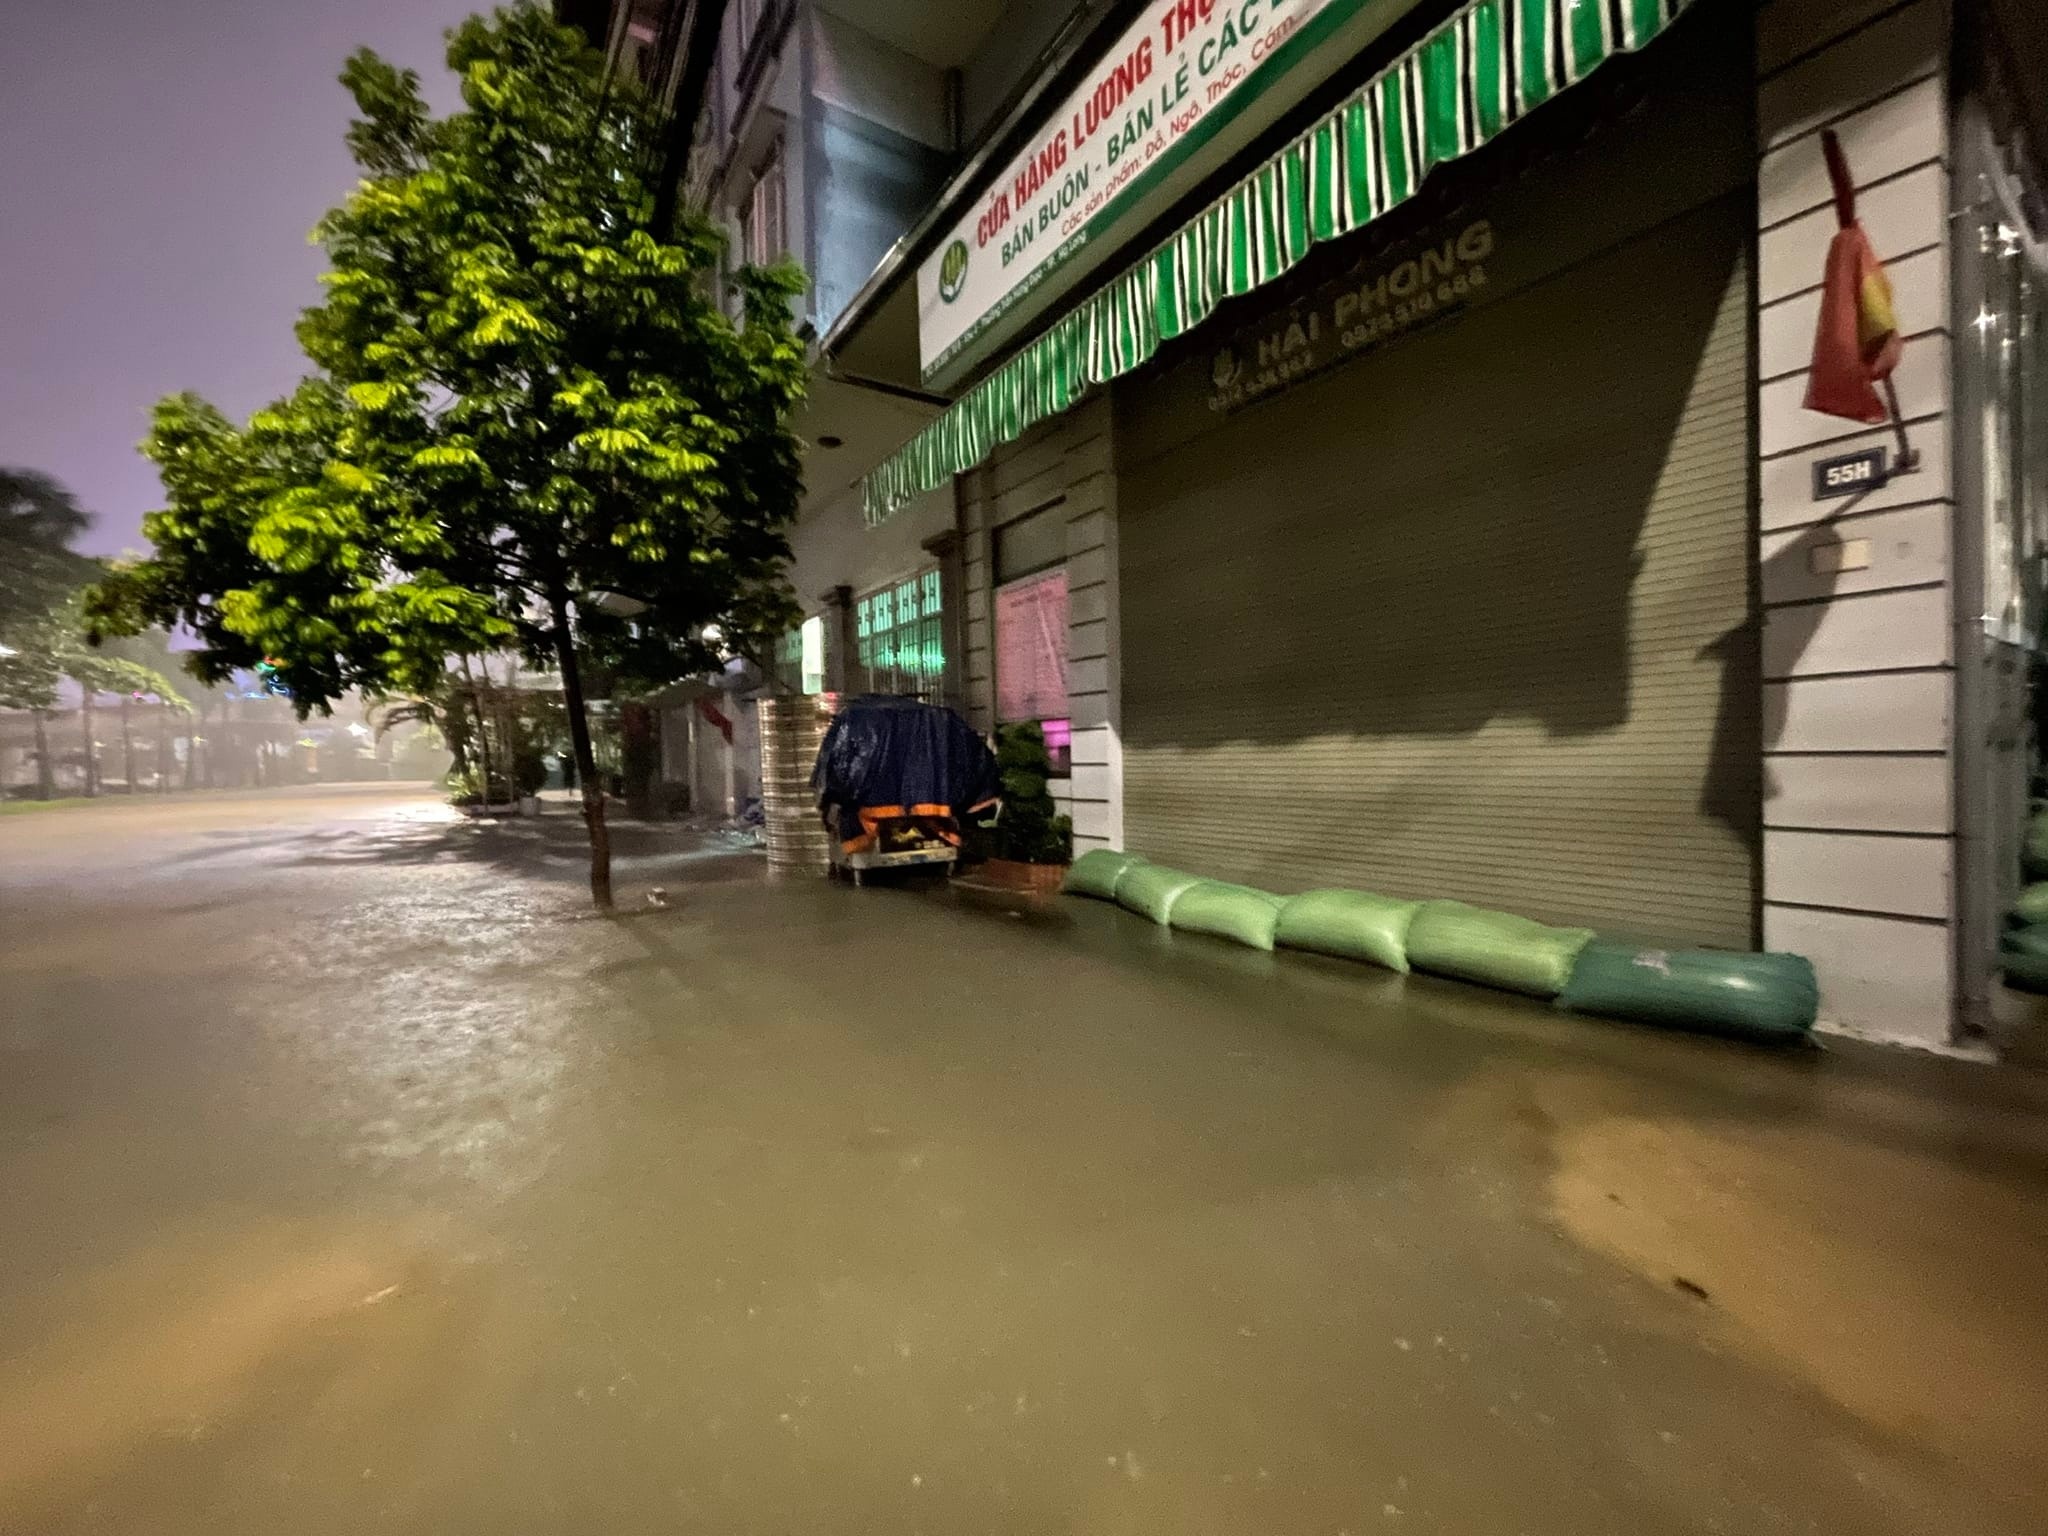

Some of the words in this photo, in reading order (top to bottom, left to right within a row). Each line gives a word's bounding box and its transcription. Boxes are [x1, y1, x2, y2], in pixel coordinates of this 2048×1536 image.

[977, 190, 1010, 248] CỬA
[1015, 129, 1067, 211] HÀNG
[1073, 36, 1152, 150] LƯƠNG
[1002, 217, 1033, 268] BÁN
[1039, 163, 1088, 232] BUÔN
[1107, 99, 1153, 167] BÁN
[1161, 51, 1189, 115] LẺ
[1198, 0, 1259, 76] CÁC
[1061, 211, 1082, 235] Các
[1085, 190, 1103, 215] sản
[1170, 100, 1202, 137] Ngô,
[1207, 64, 1246, 103] Thóc,
[1335, 220, 1494, 328] PHONG
[1826, 459, 1871, 487] 55H
